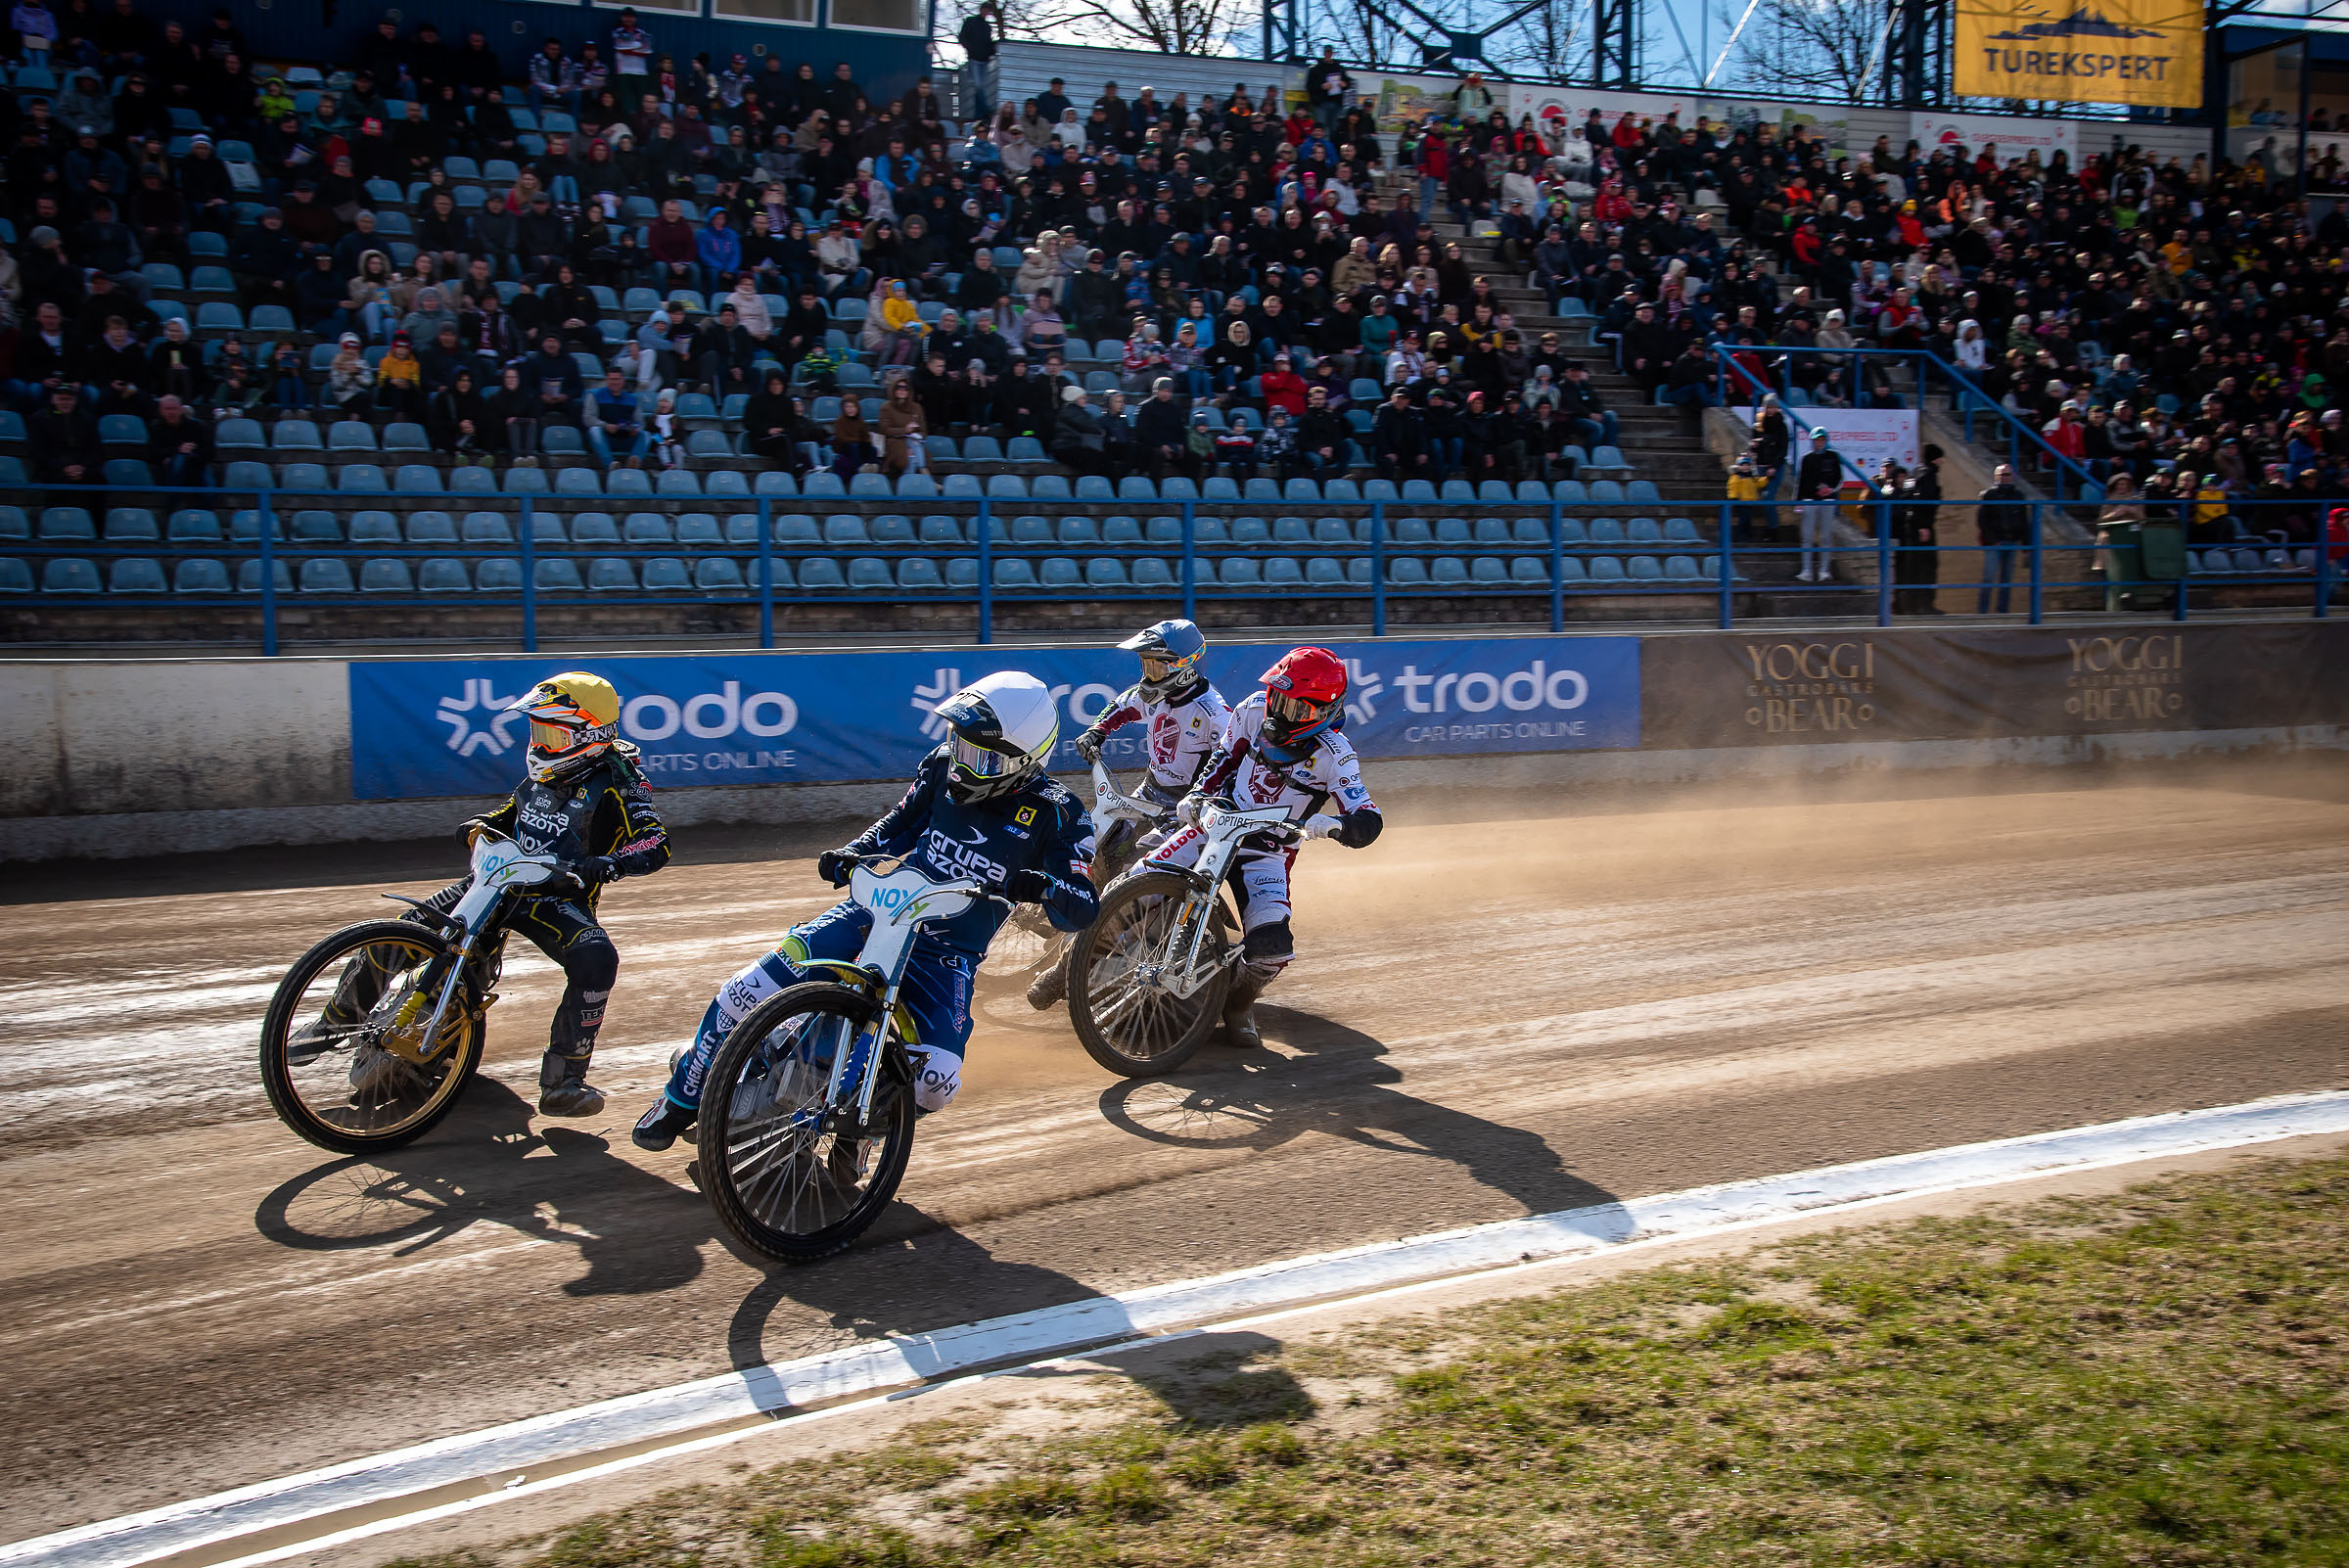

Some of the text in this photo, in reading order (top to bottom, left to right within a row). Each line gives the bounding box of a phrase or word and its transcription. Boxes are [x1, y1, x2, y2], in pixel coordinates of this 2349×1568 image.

[1983, 48, 2170, 80] TUREKSPERT
[1746, 642, 1874, 680] YOGGI
[2067, 635, 2183, 671] YOGGI
[1393, 660, 1589, 714] trodo
[2082, 687, 2169, 721] BEAR
[620, 680, 799, 741] odo
[1766, 697, 1859, 733] BEAR
[1405, 720, 1587, 743] CAR PARTS ONLINE
[638, 750, 798, 772] ARTS ONLINE
[1106, 790, 1135, 815] OPTIBET
[1218, 814, 1255, 830] OPTIBET
[683, 1030, 716, 1097] CHEMART
